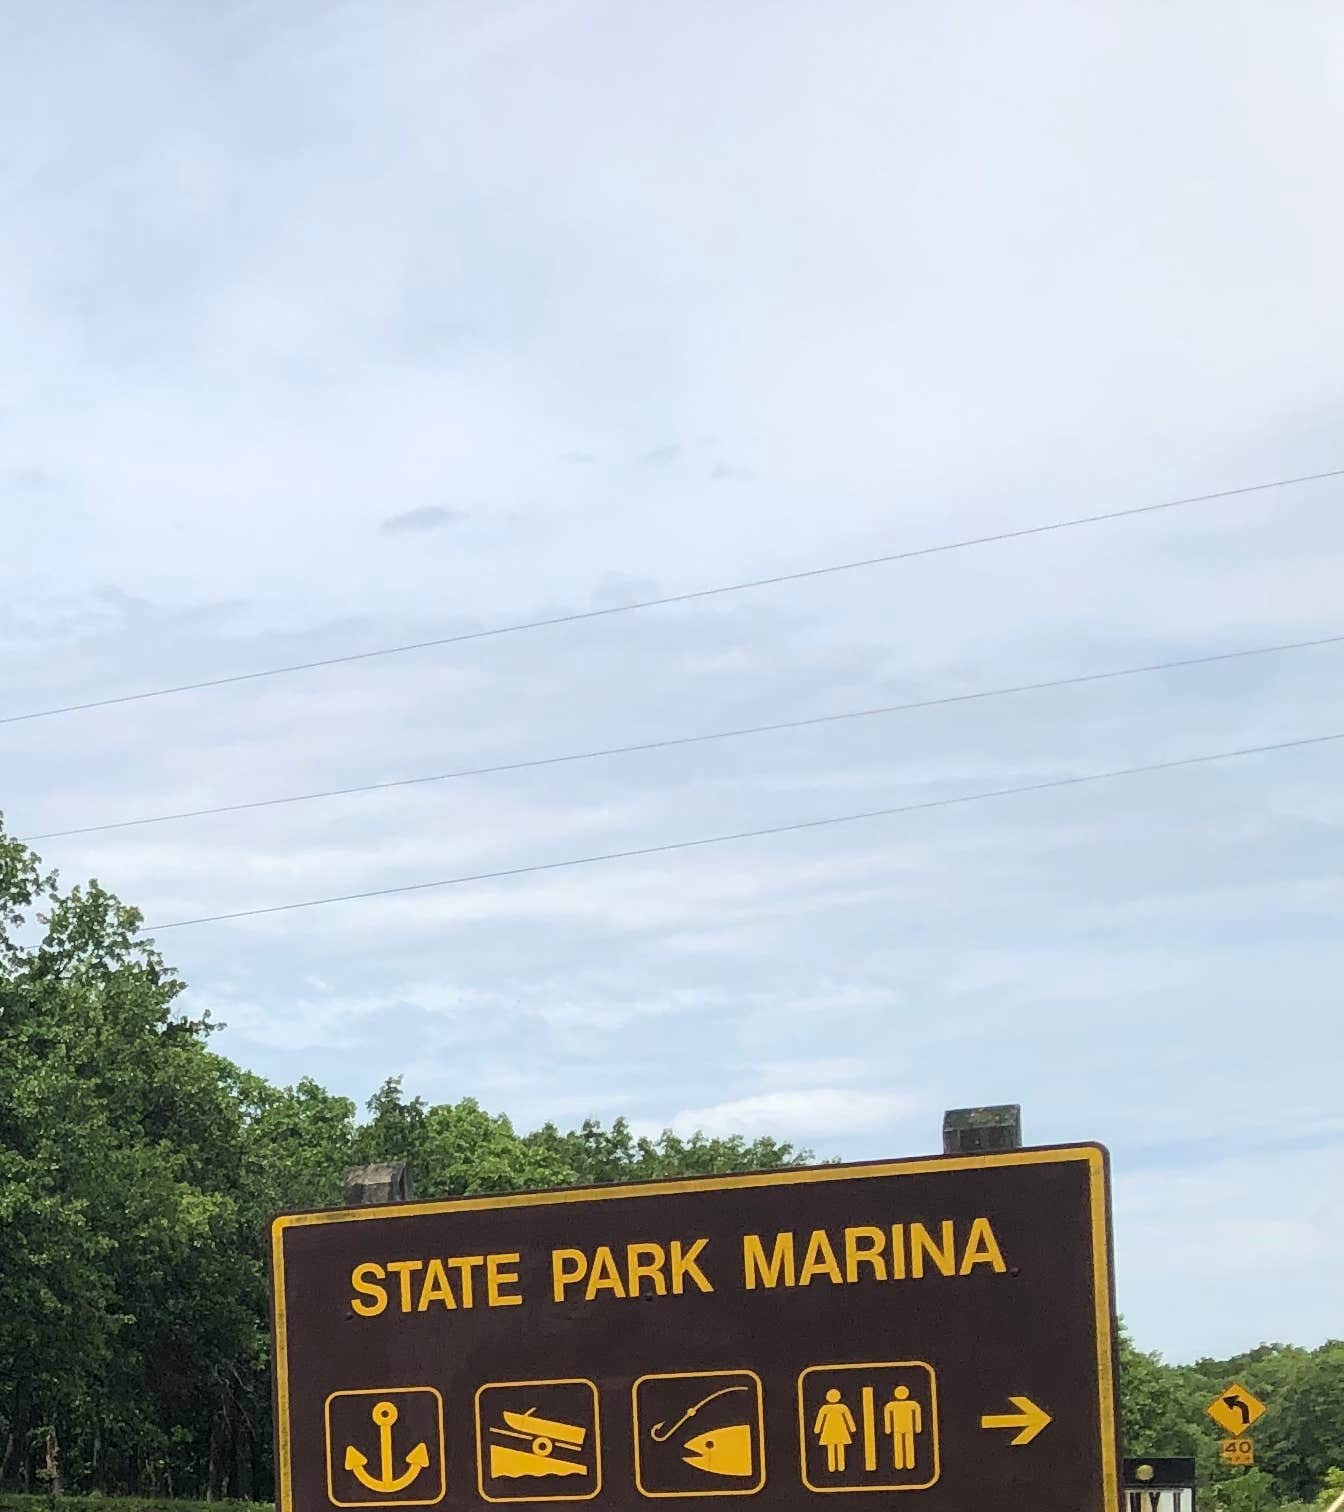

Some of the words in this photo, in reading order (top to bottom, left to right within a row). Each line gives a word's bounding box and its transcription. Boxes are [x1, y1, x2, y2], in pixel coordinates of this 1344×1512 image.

[350, 1252, 523, 1318] STATE
[551, 1238, 715, 1303] PARK
[742, 1217, 1008, 1291] MARINA
[1224, 1441, 1252, 1454] 40
